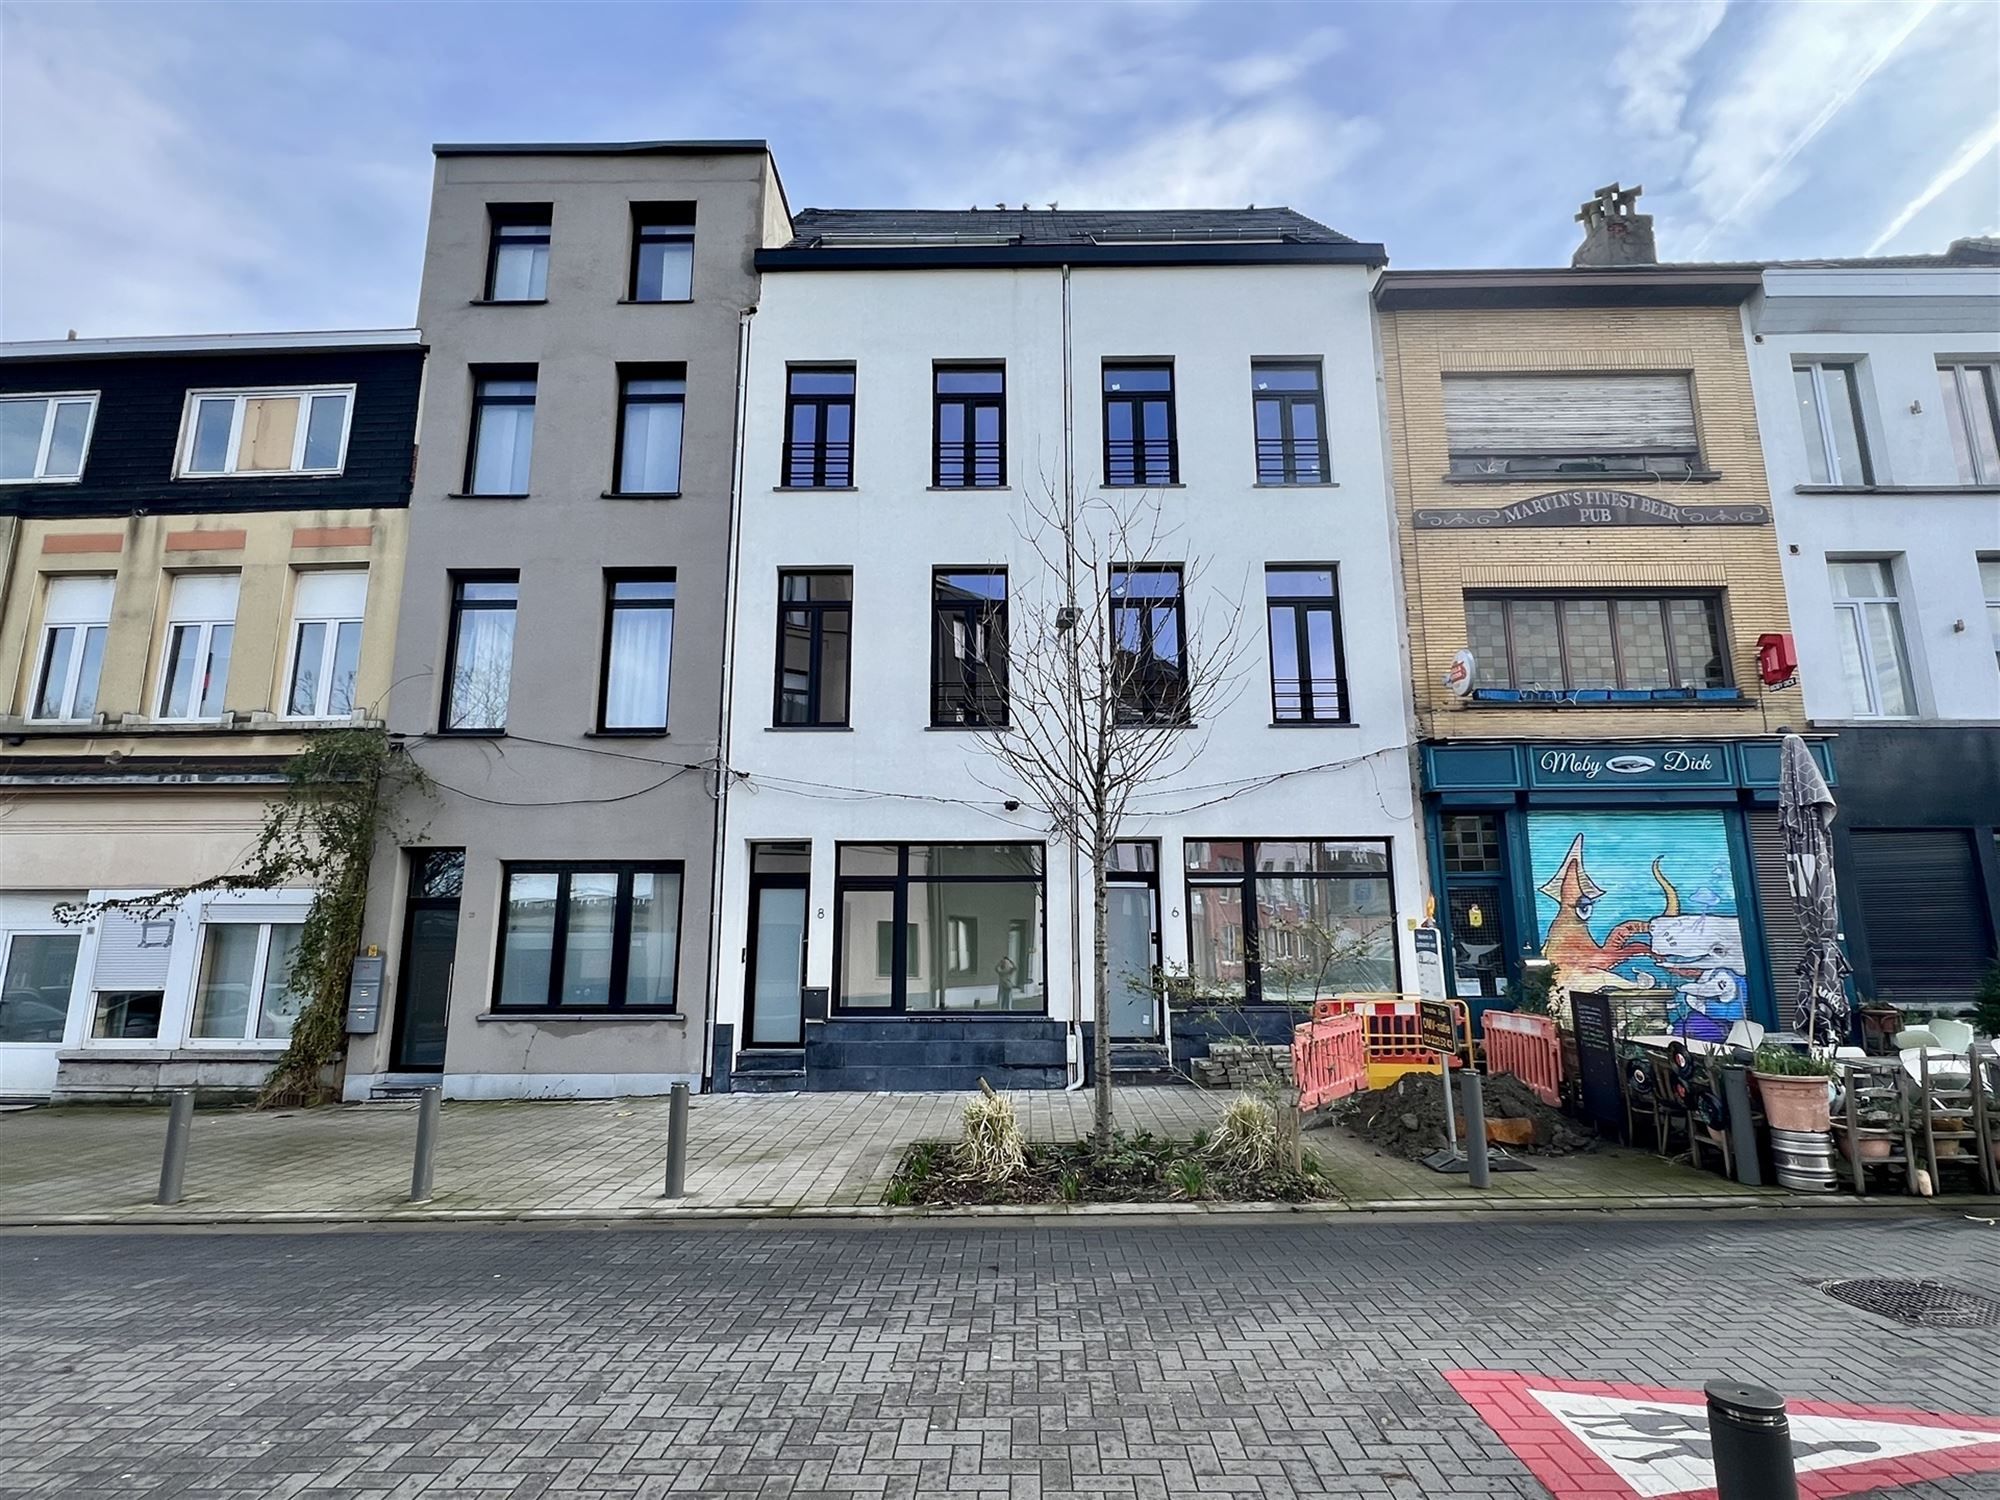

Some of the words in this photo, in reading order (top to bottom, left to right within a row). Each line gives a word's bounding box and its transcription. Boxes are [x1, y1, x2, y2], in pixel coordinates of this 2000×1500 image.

[1502, 491, 1583, 524] MARTIN'S
[1586, 491, 1639, 509] FINEST
[1640, 497, 1681, 523] BEER
[1580, 508, 1612, 522] PUB
[1540, 751, 1603, 779] Moby
[1664, 751, 1712, 772] Dick
[817, 907, 825, 919] 8
[1171, 906, 1180, 918] 6
